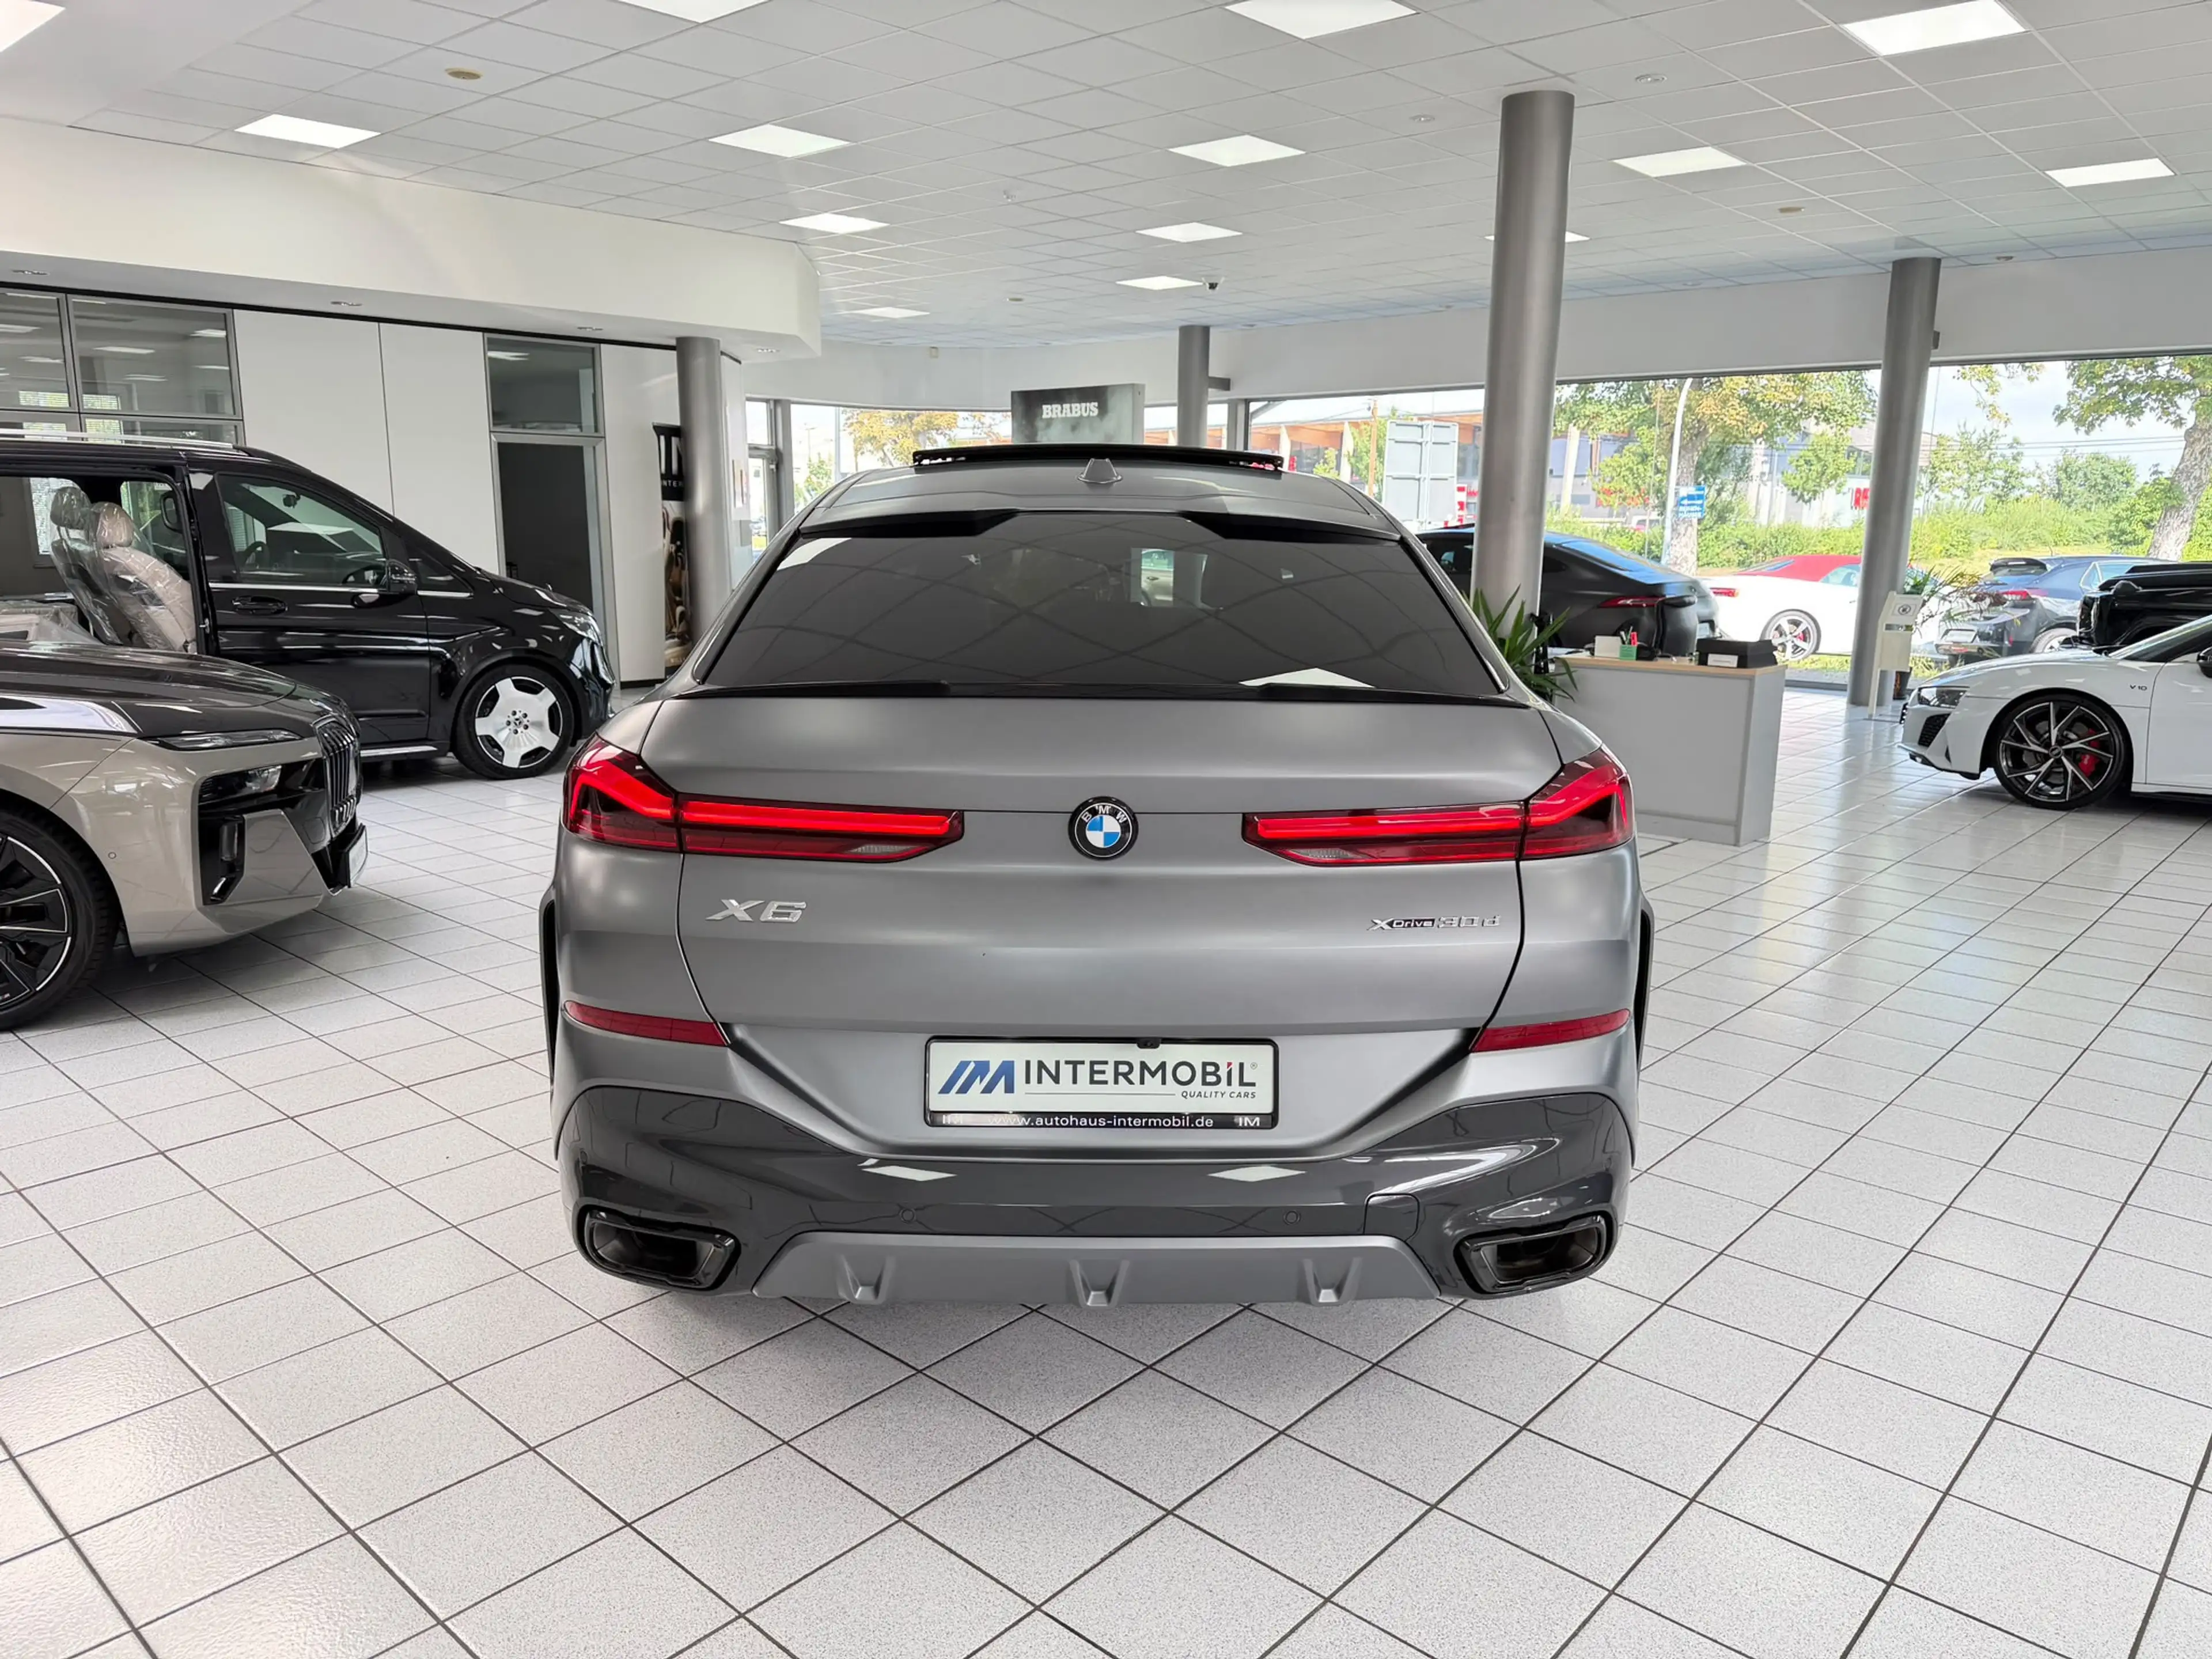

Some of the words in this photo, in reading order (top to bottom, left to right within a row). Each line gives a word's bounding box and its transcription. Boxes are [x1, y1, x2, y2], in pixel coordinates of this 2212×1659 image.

[1042, 402, 1099, 419] BRABUS
[1081, 805, 1127, 823] BMW
[705, 899, 806, 923] X6
[1181, 1090, 1226, 1099] QUALITY
[1229, 1091, 1256, 1099] CARS
[987, 1115, 1214, 1127] www.autohaus-intermobil.de
[1238, 1116, 1260, 1127] IM
